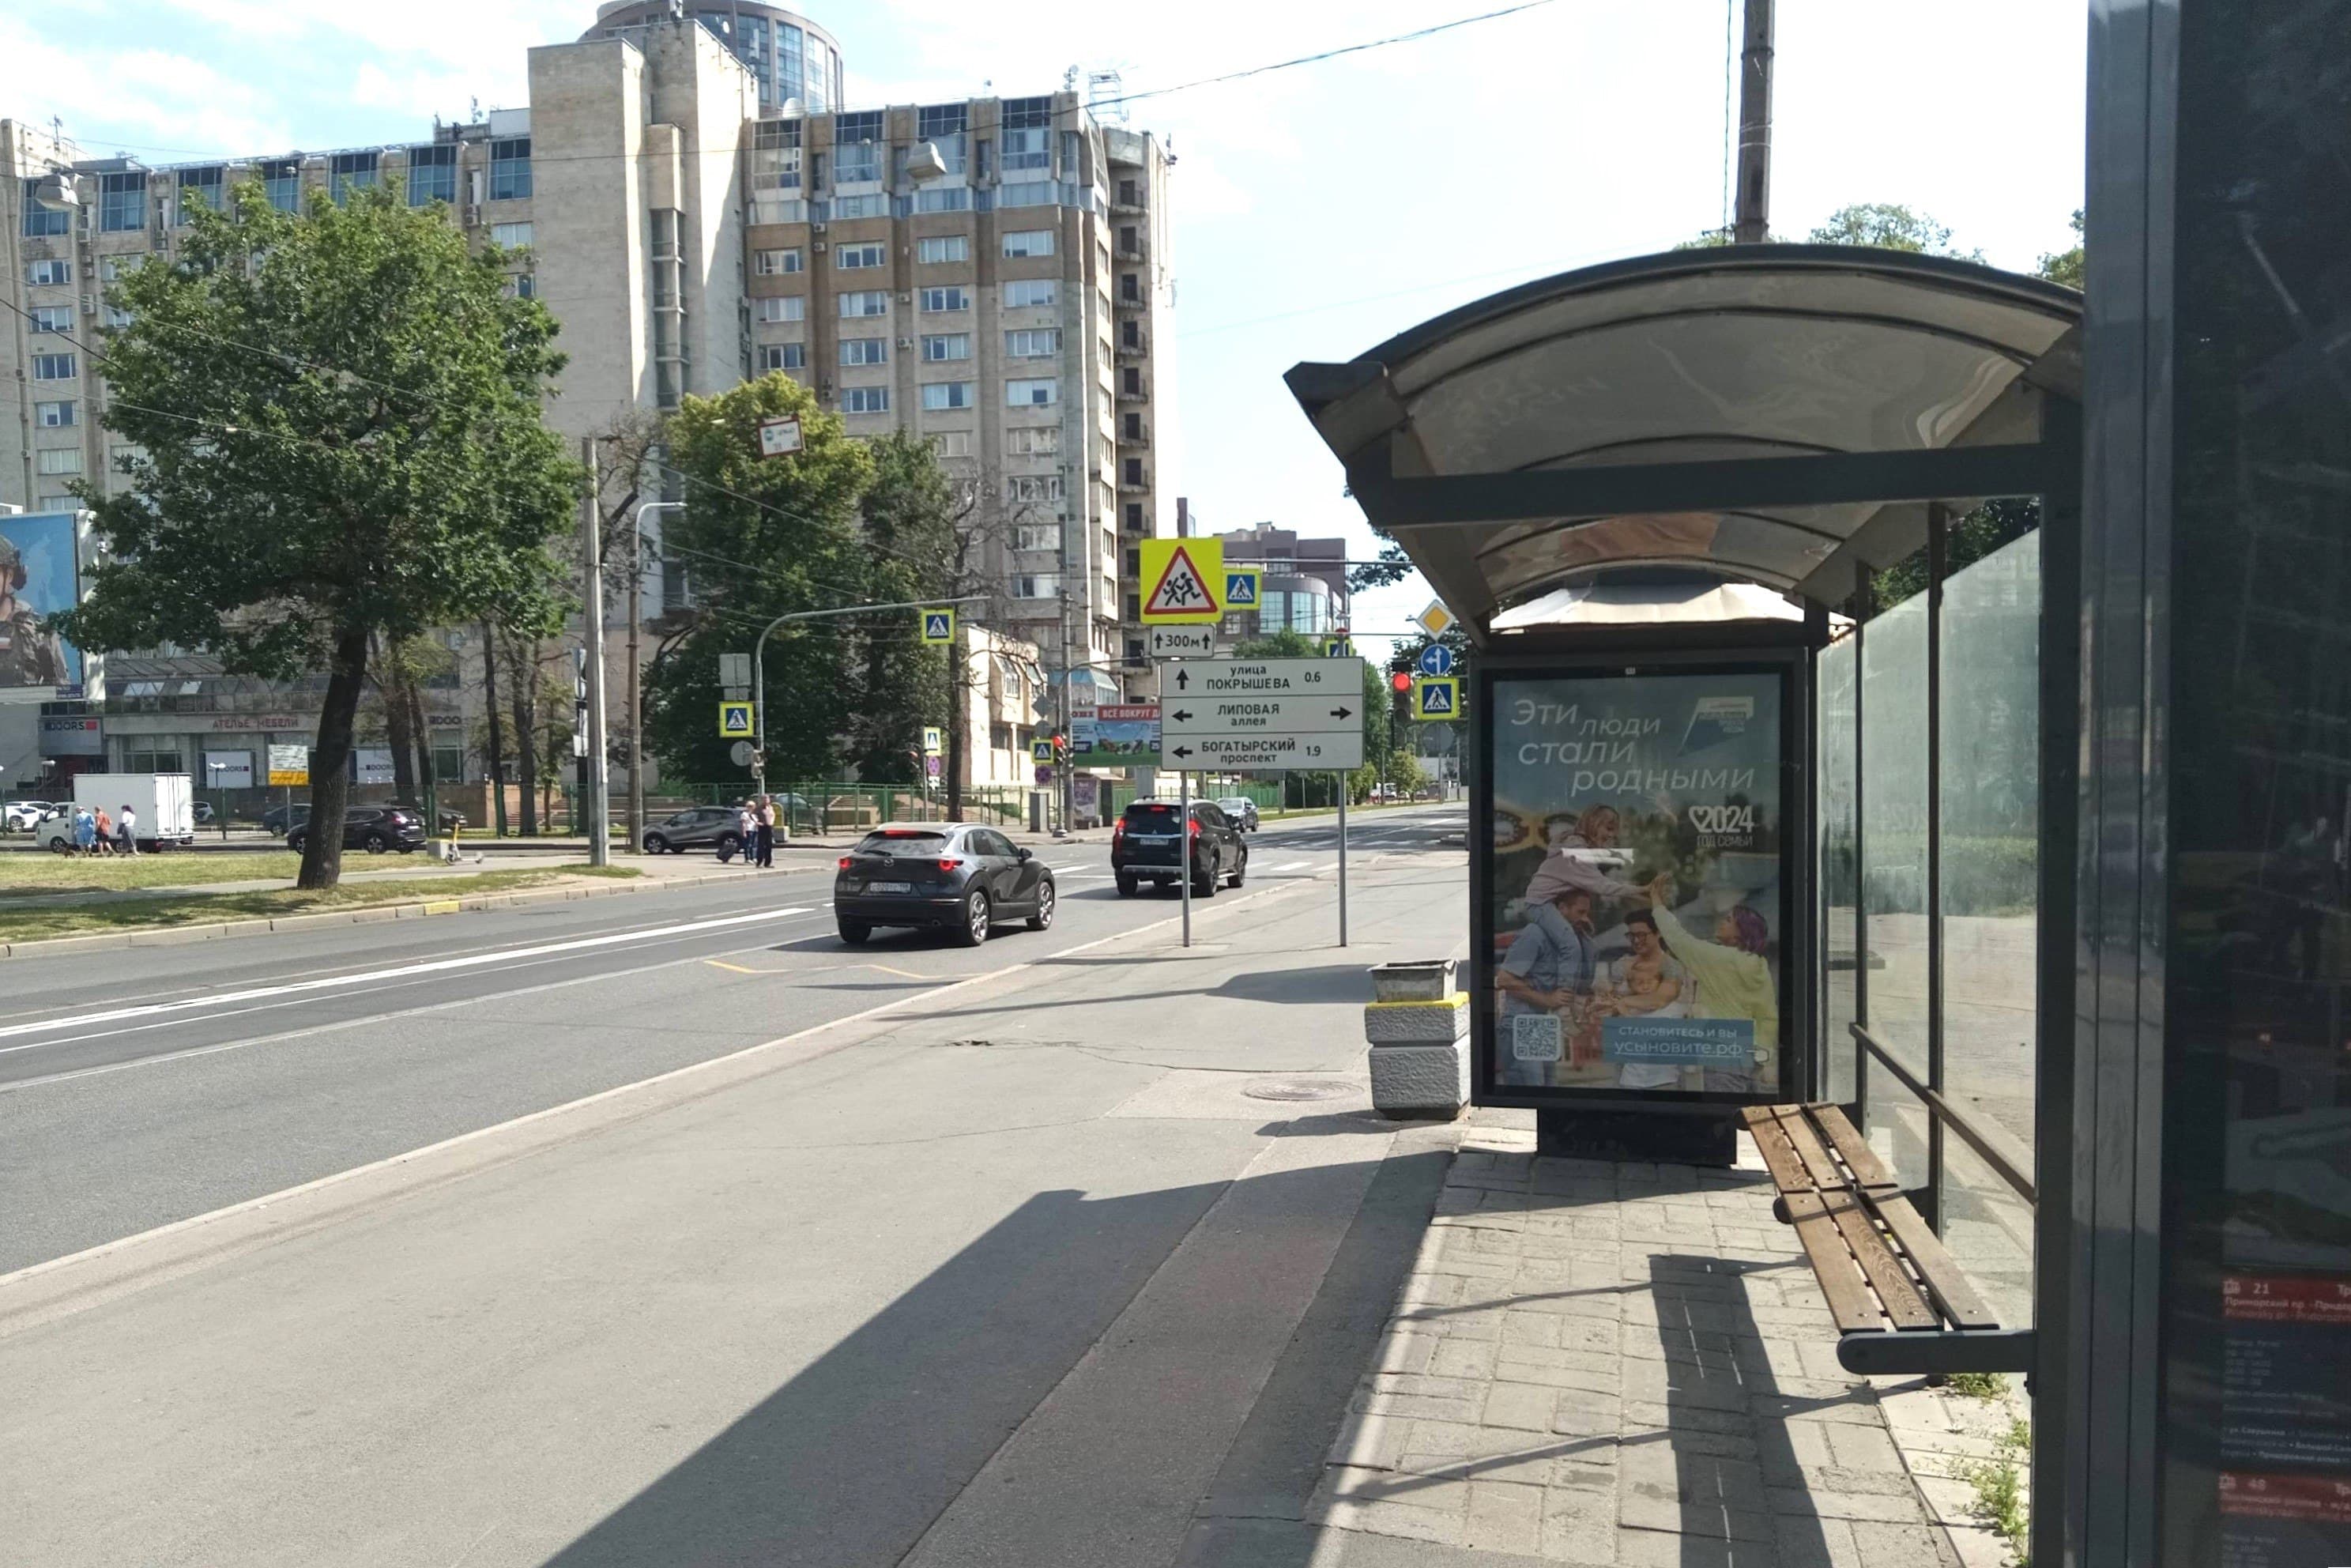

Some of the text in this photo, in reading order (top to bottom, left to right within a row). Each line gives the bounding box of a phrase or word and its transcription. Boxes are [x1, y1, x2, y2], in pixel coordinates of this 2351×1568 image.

[1166, 634, 1200, 647] 300м
[1230, 665, 1267, 677] улица
[1207, 677, 1290, 690] ПОКРЫШЕВА
[1217, 703, 1279, 715] ЛИПОВАЯ
[213, 719, 250, 729] АТЕЛЬЕ
[1230, 717, 1266, 726] аллея
[1511, 699, 1662, 738] Эти люди
[1201, 737, 1296, 752] БОГАТЫРСКИЙ
[1220, 752, 1277, 765] проспект
[1518, 741, 1636, 765] стали
[1571, 767, 1756, 797] родными
[1700, 805, 1754, 833] 2024
[1697, 835, 1716, 848] ГОД
[1618, 1027, 1738, 1038] СТАНОВИТЕСЬ И ВЫ
[1614, 1040, 1743, 1057] усыновите.рф
[2253, 1282, 2270, 1295] 21
